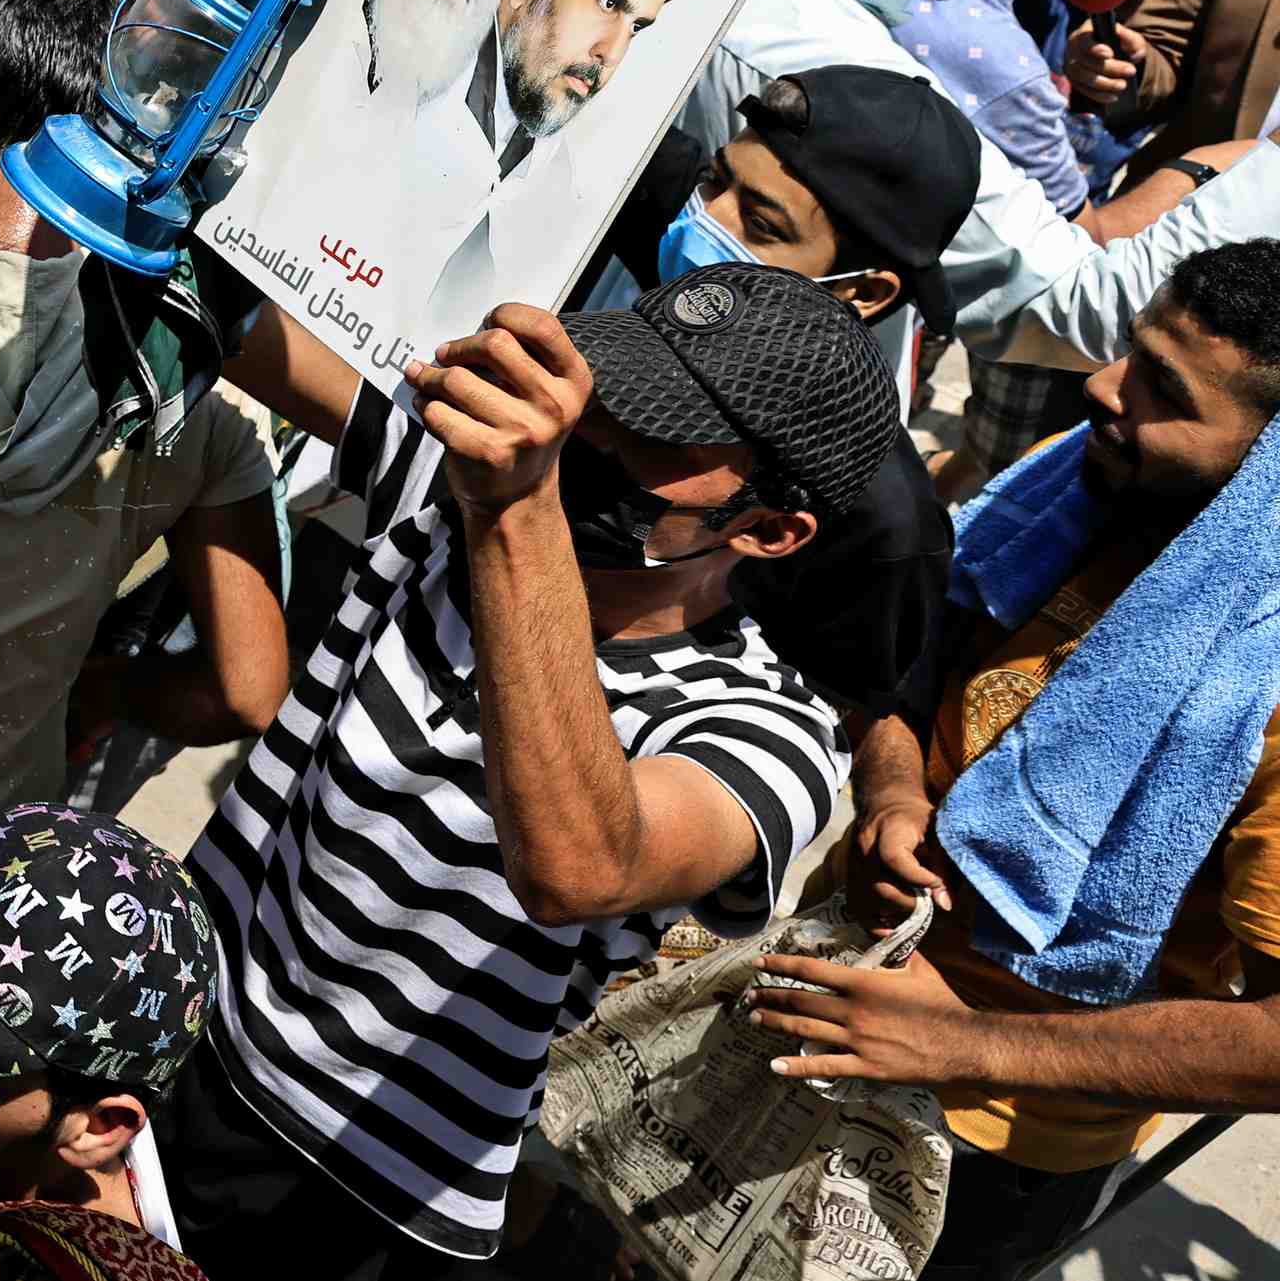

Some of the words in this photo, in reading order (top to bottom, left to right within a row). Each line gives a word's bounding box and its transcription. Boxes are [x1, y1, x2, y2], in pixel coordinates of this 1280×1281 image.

[213, 215, 315, 295] الفاسدين
[319, 233, 384, 288] مرعب
[307, 287, 374, 350] ومذل
